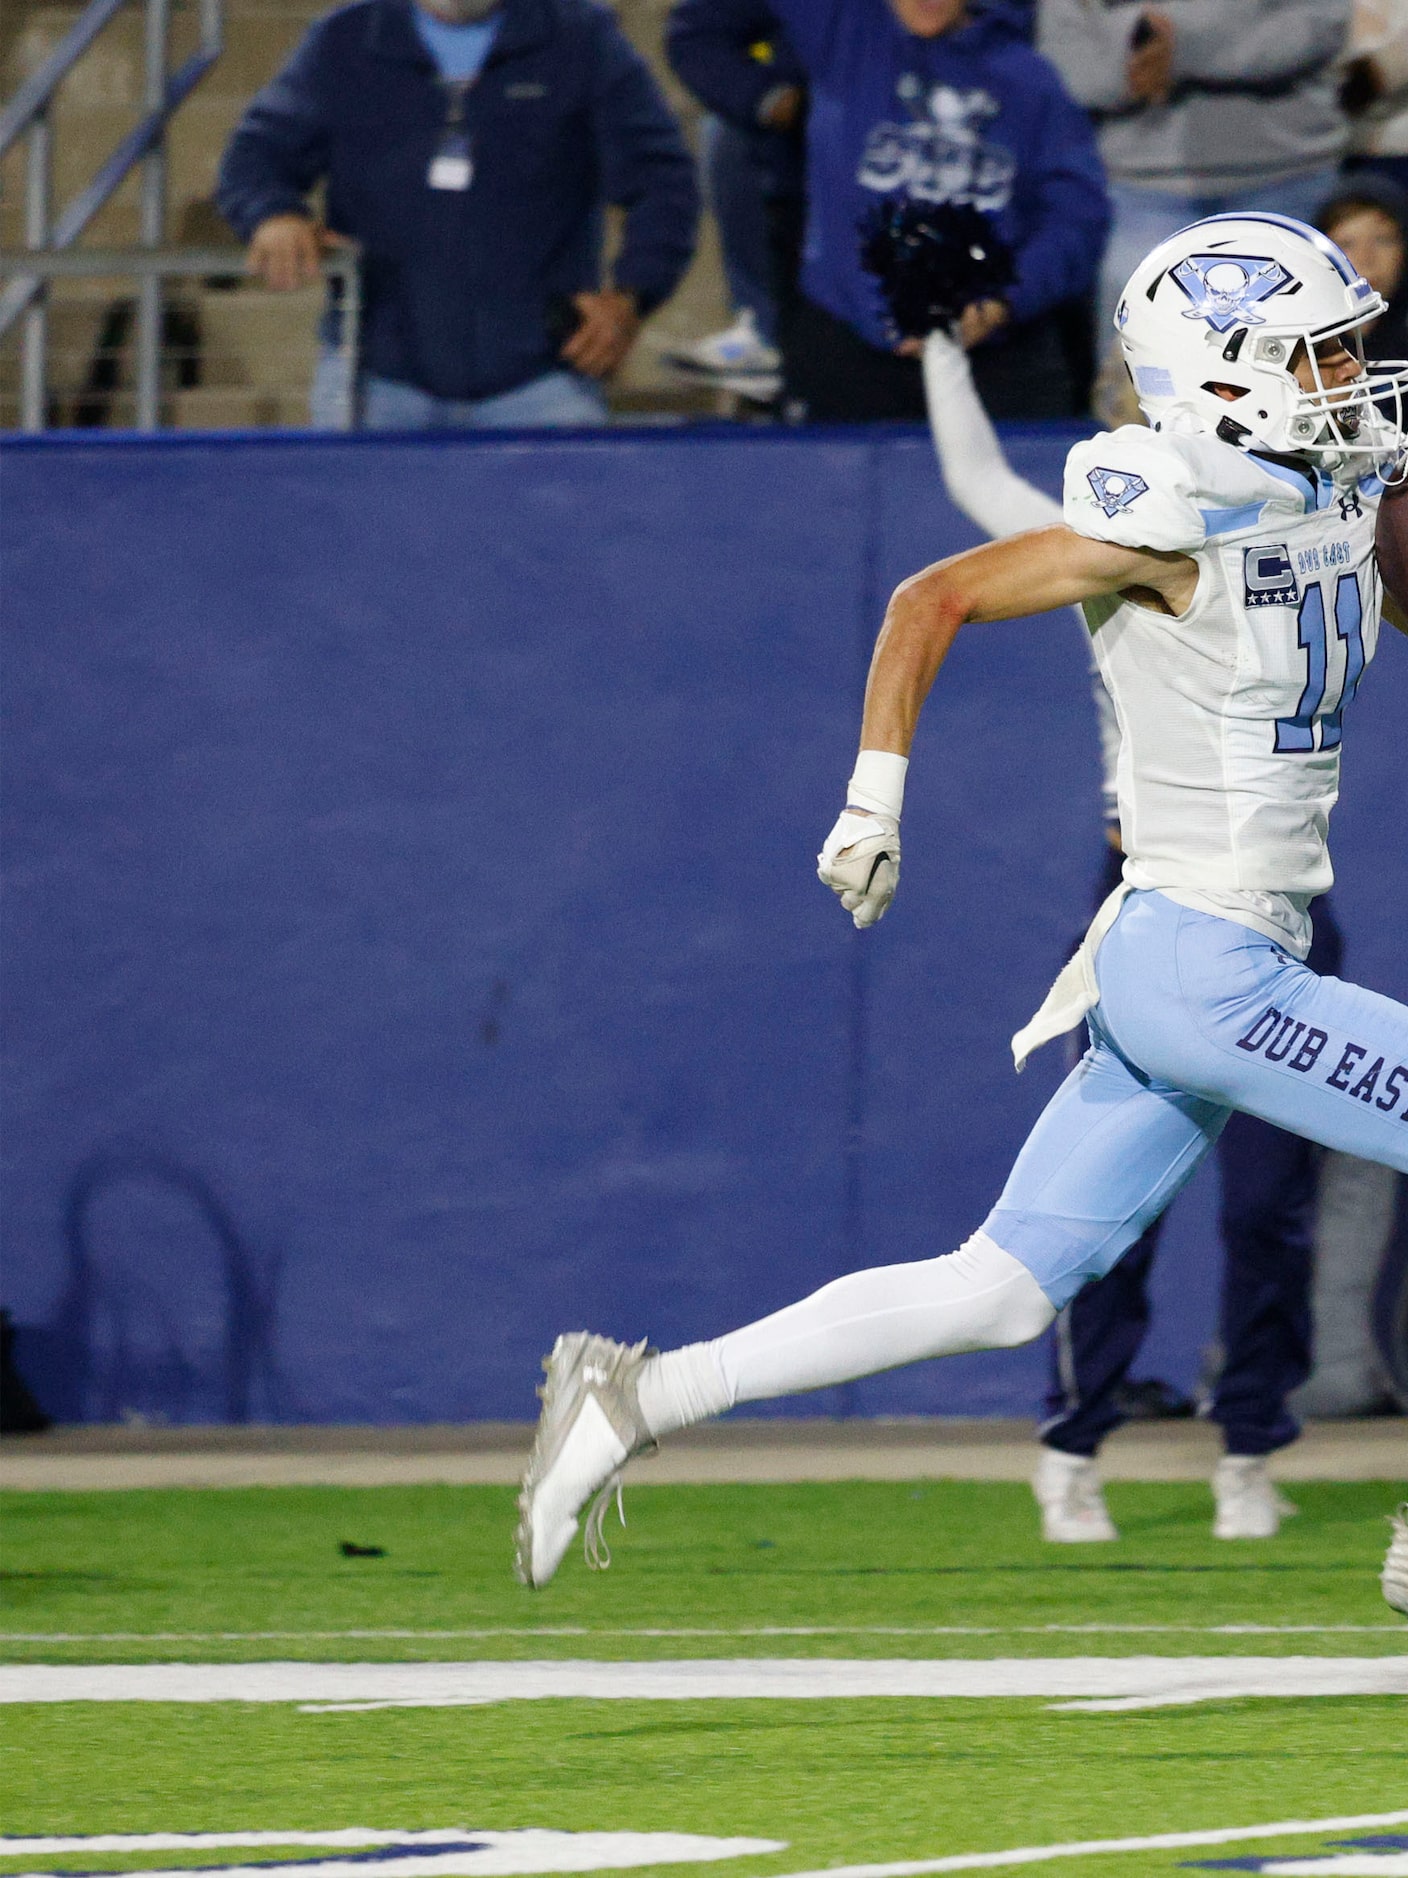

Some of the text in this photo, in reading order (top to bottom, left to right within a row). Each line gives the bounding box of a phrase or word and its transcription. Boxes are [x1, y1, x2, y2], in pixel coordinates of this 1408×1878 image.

[1245, 545, 1294, 591] C
[1322, 541, 1351, 568] EAST
[1272, 572, 1365, 753] 11
[1236, 1008, 1329, 1073] DUB
